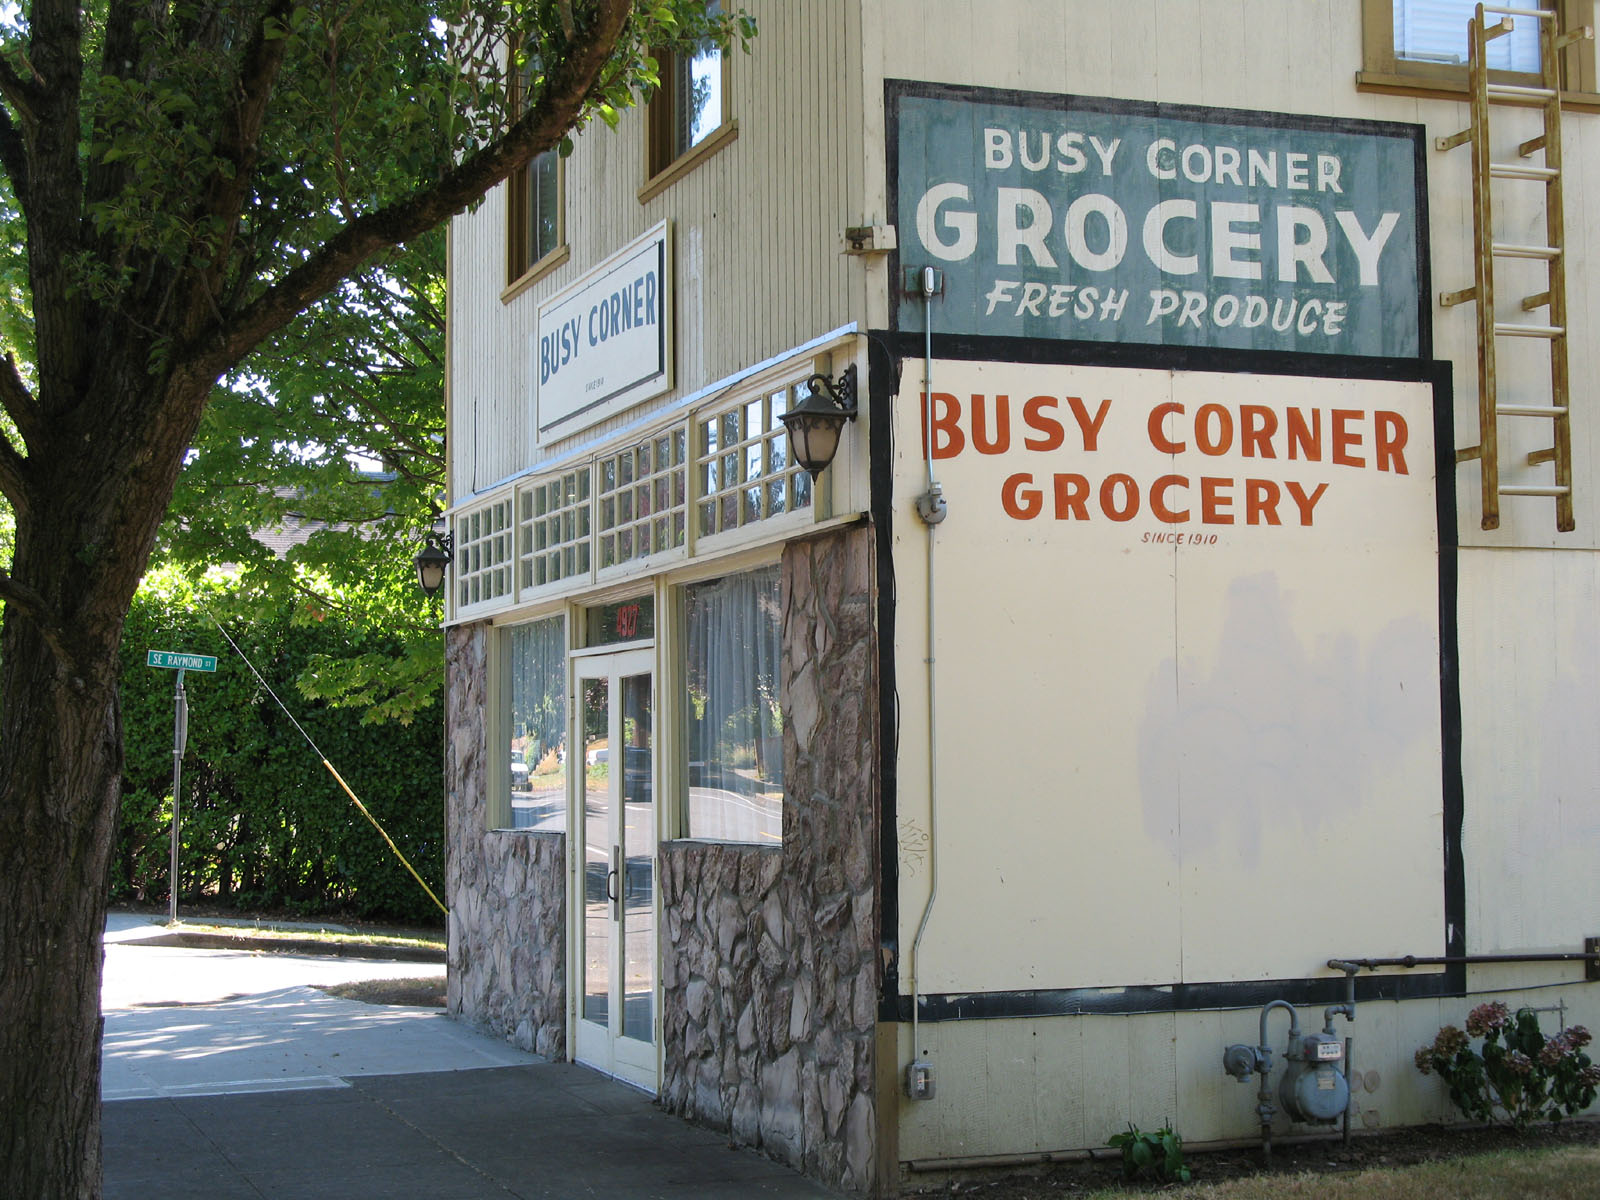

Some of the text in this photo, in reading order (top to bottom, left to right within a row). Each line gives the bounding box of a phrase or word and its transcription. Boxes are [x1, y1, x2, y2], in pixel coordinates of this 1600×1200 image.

[983, 127, 1344, 194] BUSY CORNER
[915, 182, 1400, 287] GROCERY
[541, 270, 656, 387] BUSY CORNER
[985, 280, 1349, 336] FRESH PRODUCE
[919, 392, 1410, 476] BUSY CORNER
[1001, 472, 1329, 527] GROCERY
[1141, 532, 1218, 545] SINCE 1910
[616, 603, 639, 637] 4927
[153, 653, 163, 665] SE
[167, 655, 203, 668] RAYMOND
